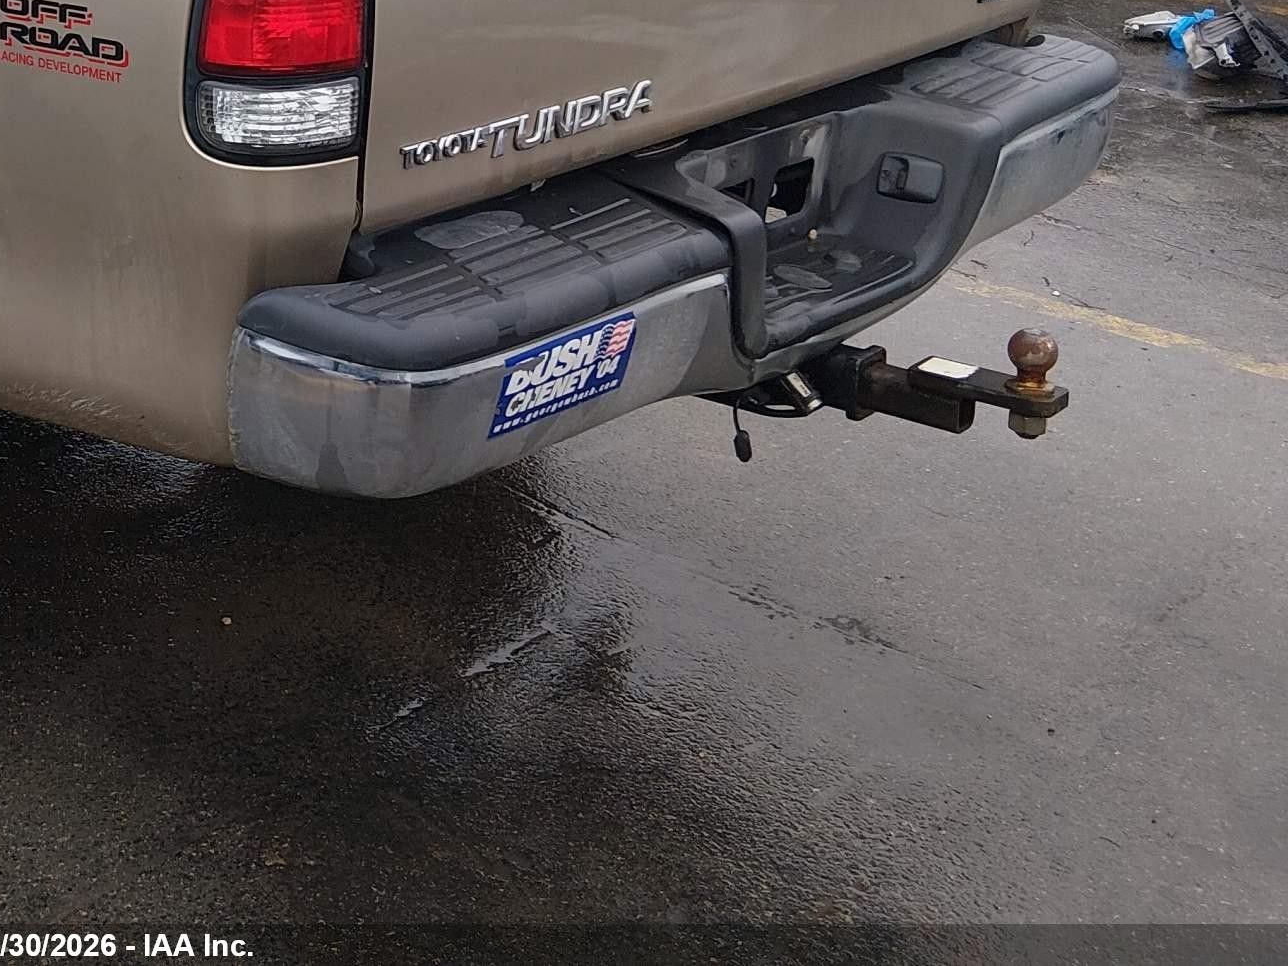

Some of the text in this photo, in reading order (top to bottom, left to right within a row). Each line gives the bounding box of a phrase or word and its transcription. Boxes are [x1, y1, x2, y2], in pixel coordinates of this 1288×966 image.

[0, 21, 129, 68] ROAD
[37, 56, 123, 84] DEVELOPMENT
[400, 79, 653, 170] TOYOTA TUNDRA
[505, 363, 593, 418] CHENEY
